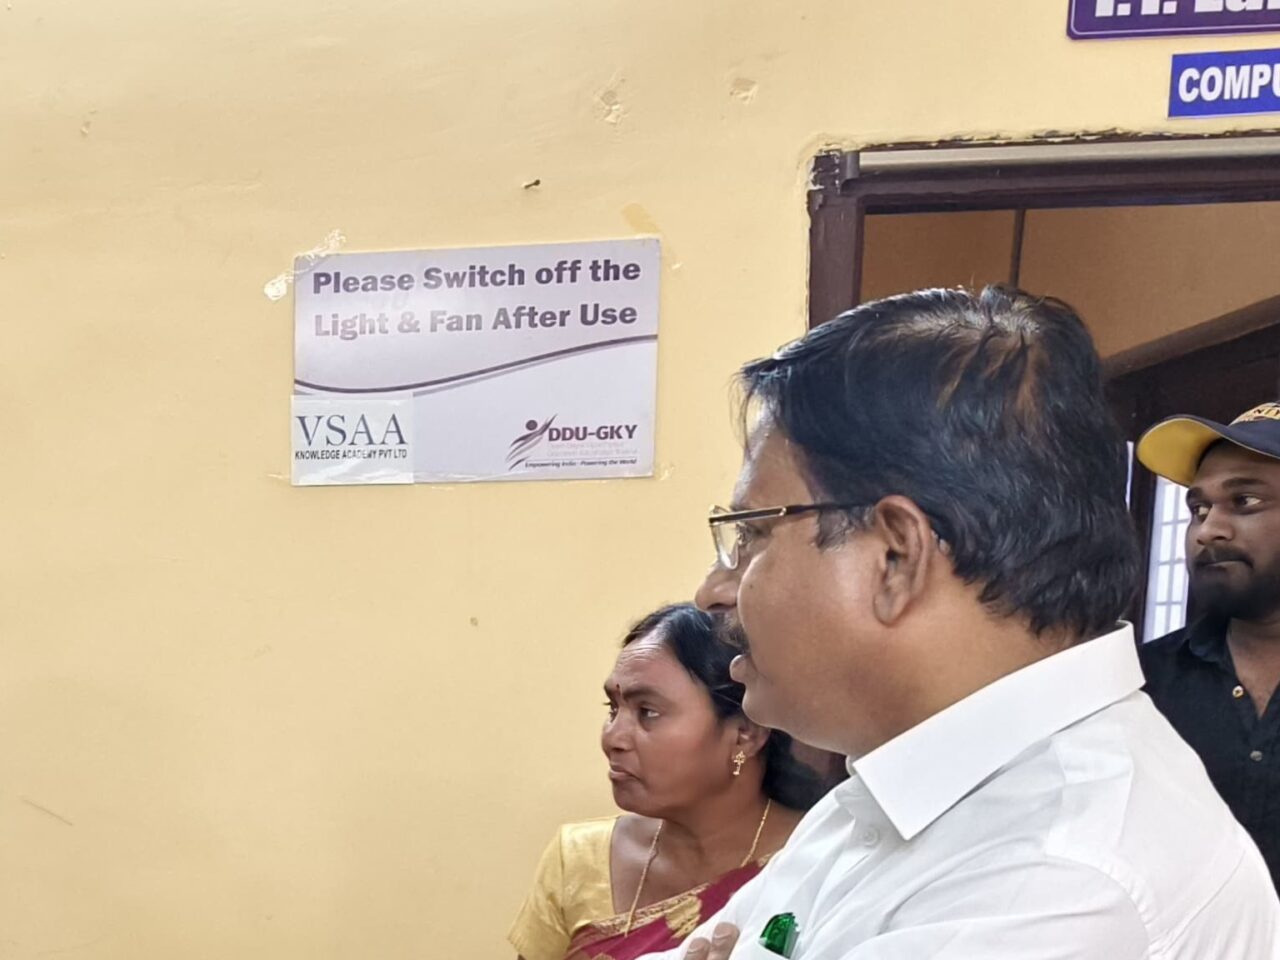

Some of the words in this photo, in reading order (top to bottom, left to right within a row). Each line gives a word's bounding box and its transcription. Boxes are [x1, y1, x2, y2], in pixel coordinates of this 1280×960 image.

[1179, 64, 1280, 102] COMP
[312, 268, 414, 294] Please
[423, 264, 525, 290] Switch
[535, 260, 583, 285] off
[589, 258, 641, 282] the
[315, 313, 389, 341] Light
[398, 312, 420, 334] &
[430, 310, 482, 332] Fan
[492, 306, 571, 331] After
[580, 303, 638, 326] Use
[296, 414, 408, 447] VSAA
[548, 424, 637, 441] DDU-GKY
[295, 449, 340, 460] KNOWLEDGE
[379, 449, 394, 459] PVT
[394, 449, 407, 459] LTD
